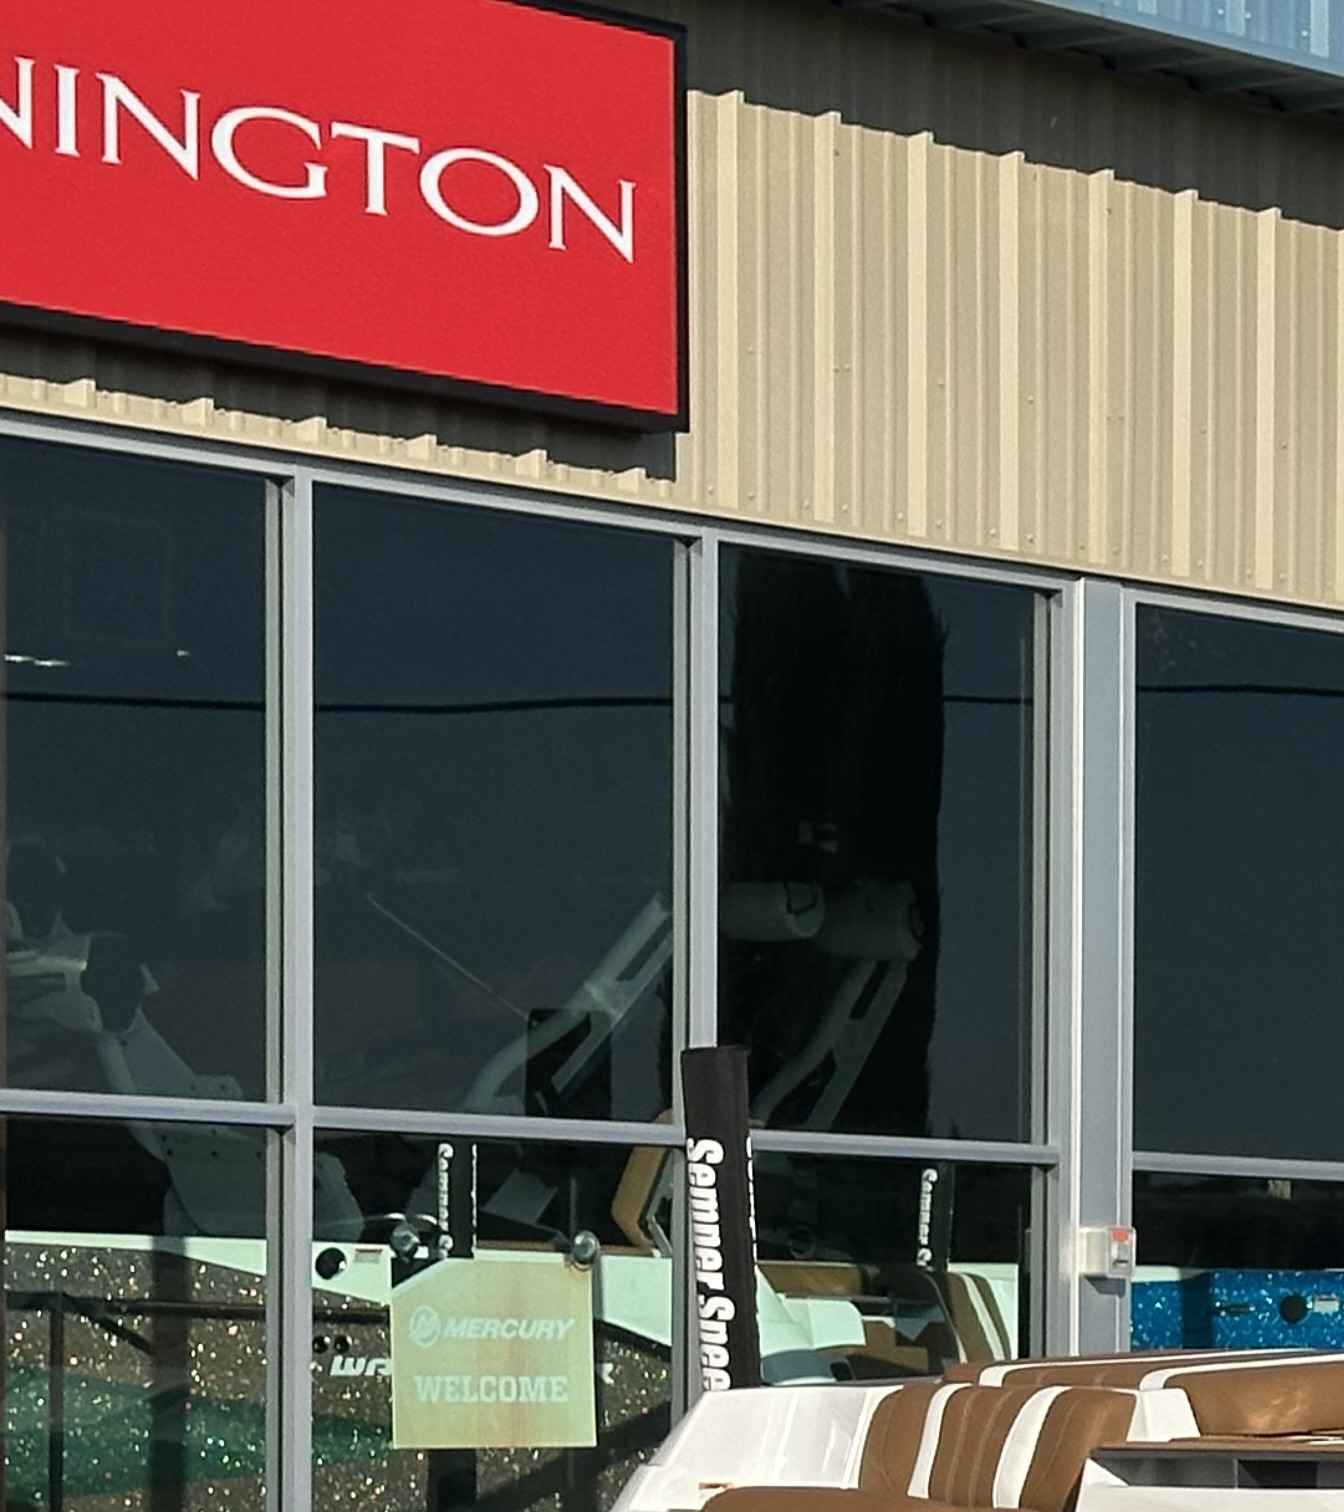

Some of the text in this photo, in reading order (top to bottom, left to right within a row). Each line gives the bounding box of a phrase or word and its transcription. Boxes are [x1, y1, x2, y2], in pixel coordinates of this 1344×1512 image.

[442, 1317, 575, 1341] MERCURY
[697, 1294, 736, 1391] Spee
[415, 1375, 569, 1402] WELCOME
